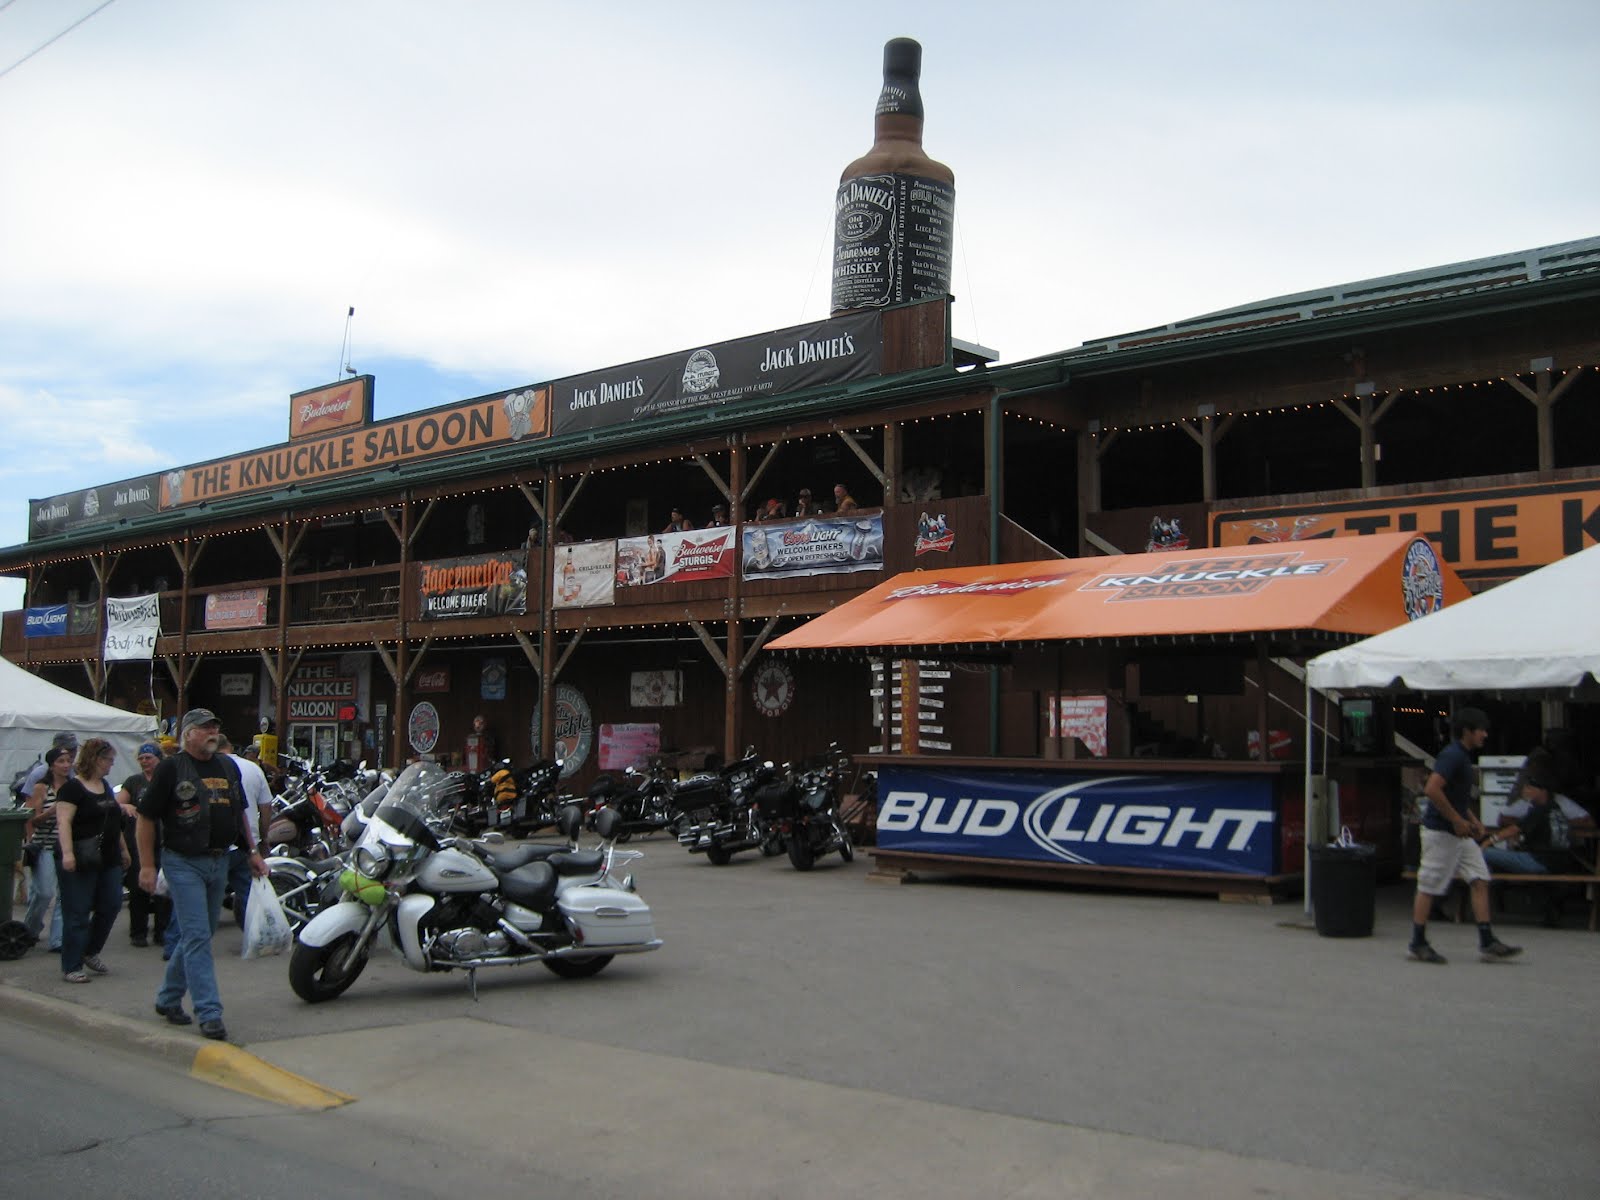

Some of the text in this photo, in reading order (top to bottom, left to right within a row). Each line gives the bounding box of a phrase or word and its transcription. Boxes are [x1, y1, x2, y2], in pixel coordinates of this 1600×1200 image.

[851, 183, 895, 210] DANIEL'S
[899, 180, 907, 228] DISTILLERY
[836, 246, 880, 261] Tennessee
[834, 262, 882, 278] WHISKEY
[761, 332, 855, 372] JACK DANIEL'S
[570, 387, 597, 411] JACK
[600, 375, 644, 404] DANIEL'S
[687, 396, 698, 404] THE
[299, 390, 352, 423] Budweiser
[192, 406, 494, 497] THE KNUCKLE SALOON
[114, 485, 151, 507] JACK DANIEL'S
[37, 508, 51, 521] JACK
[783, 529, 843, 546] Coors LIGHT
[778, 543, 844, 555] WELCOME BIKERS
[805, 550, 849, 561] REFRESHMENT
[680, 553, 714, 571] STURGIS
[1099, 563, 1327, 587] KNUCKLE
[886, 578, 1067, 599] Budweiser
[1127, 580, 1256, 599] SALOON
[428, 593, 488, 611] WELCOME BIKERS
[27, 614, 67, 625] BUD LIGHT
[107, 635, 134, 653] Body
[297, 666, 334, 679] THE
[288, 681, 352, 696] NUCKLE
[291, 701, 335, 717] SALOON
[556, 712, 591, 738] uckle
[877, 791, 1277, 852] BUD LIGHT
